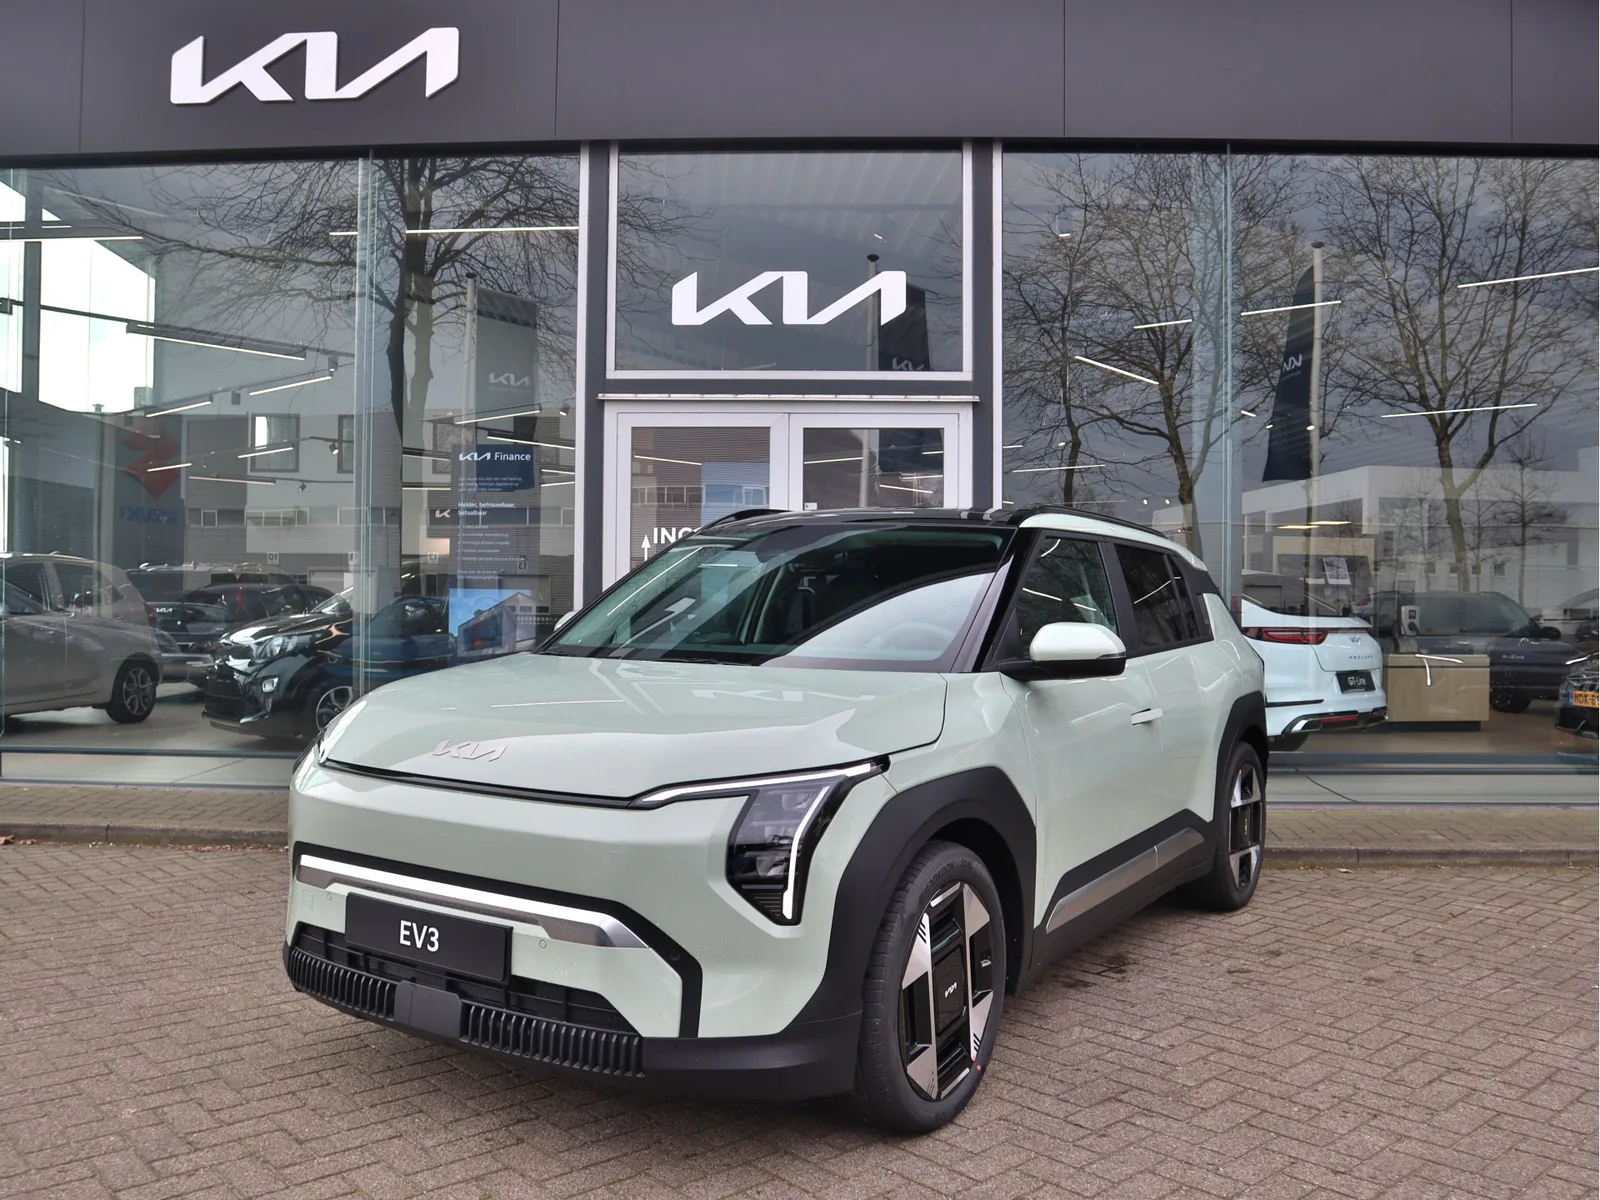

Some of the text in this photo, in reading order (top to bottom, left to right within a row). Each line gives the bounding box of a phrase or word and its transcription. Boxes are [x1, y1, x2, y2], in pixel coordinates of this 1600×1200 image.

[171, 27, 460, 104] KIA
[672, 270, 907, 326] KIA
[488, 372, 531, 386] KIA
[459, 452, 531, 461] KIA Finance
[1347, 676, 1367, 686] GT-Line
[432, 739, 507, 763] KIA
[398, 919, 441, 953] EV3
